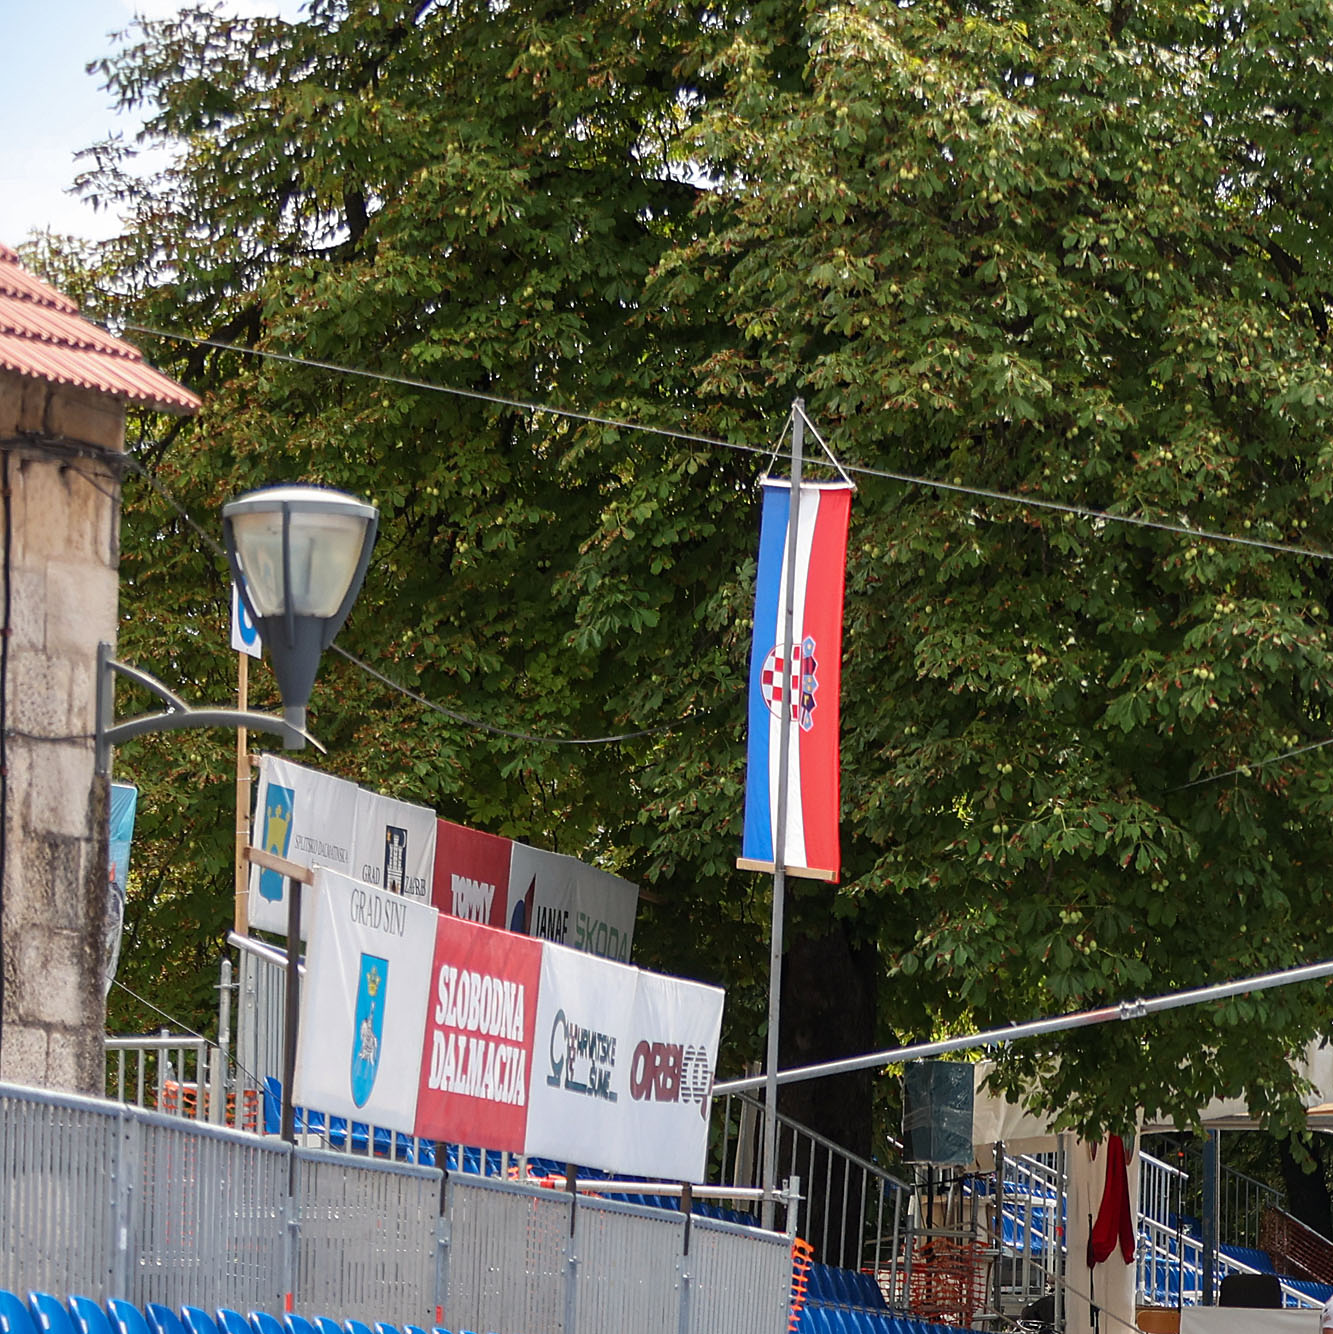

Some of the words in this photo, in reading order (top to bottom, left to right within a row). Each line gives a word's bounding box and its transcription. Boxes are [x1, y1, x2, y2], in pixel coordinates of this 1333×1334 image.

[362, 864, 381, 885] GRAD
[451, 873, 496, 925] TOMMY
[351, 888, 382, 929] GRAD
[384, 899, 407, 938] SINJ
[435, 964, 525, 1043] SLOBODNA
[428, 1029, 526, 1106] DALMACIJA
